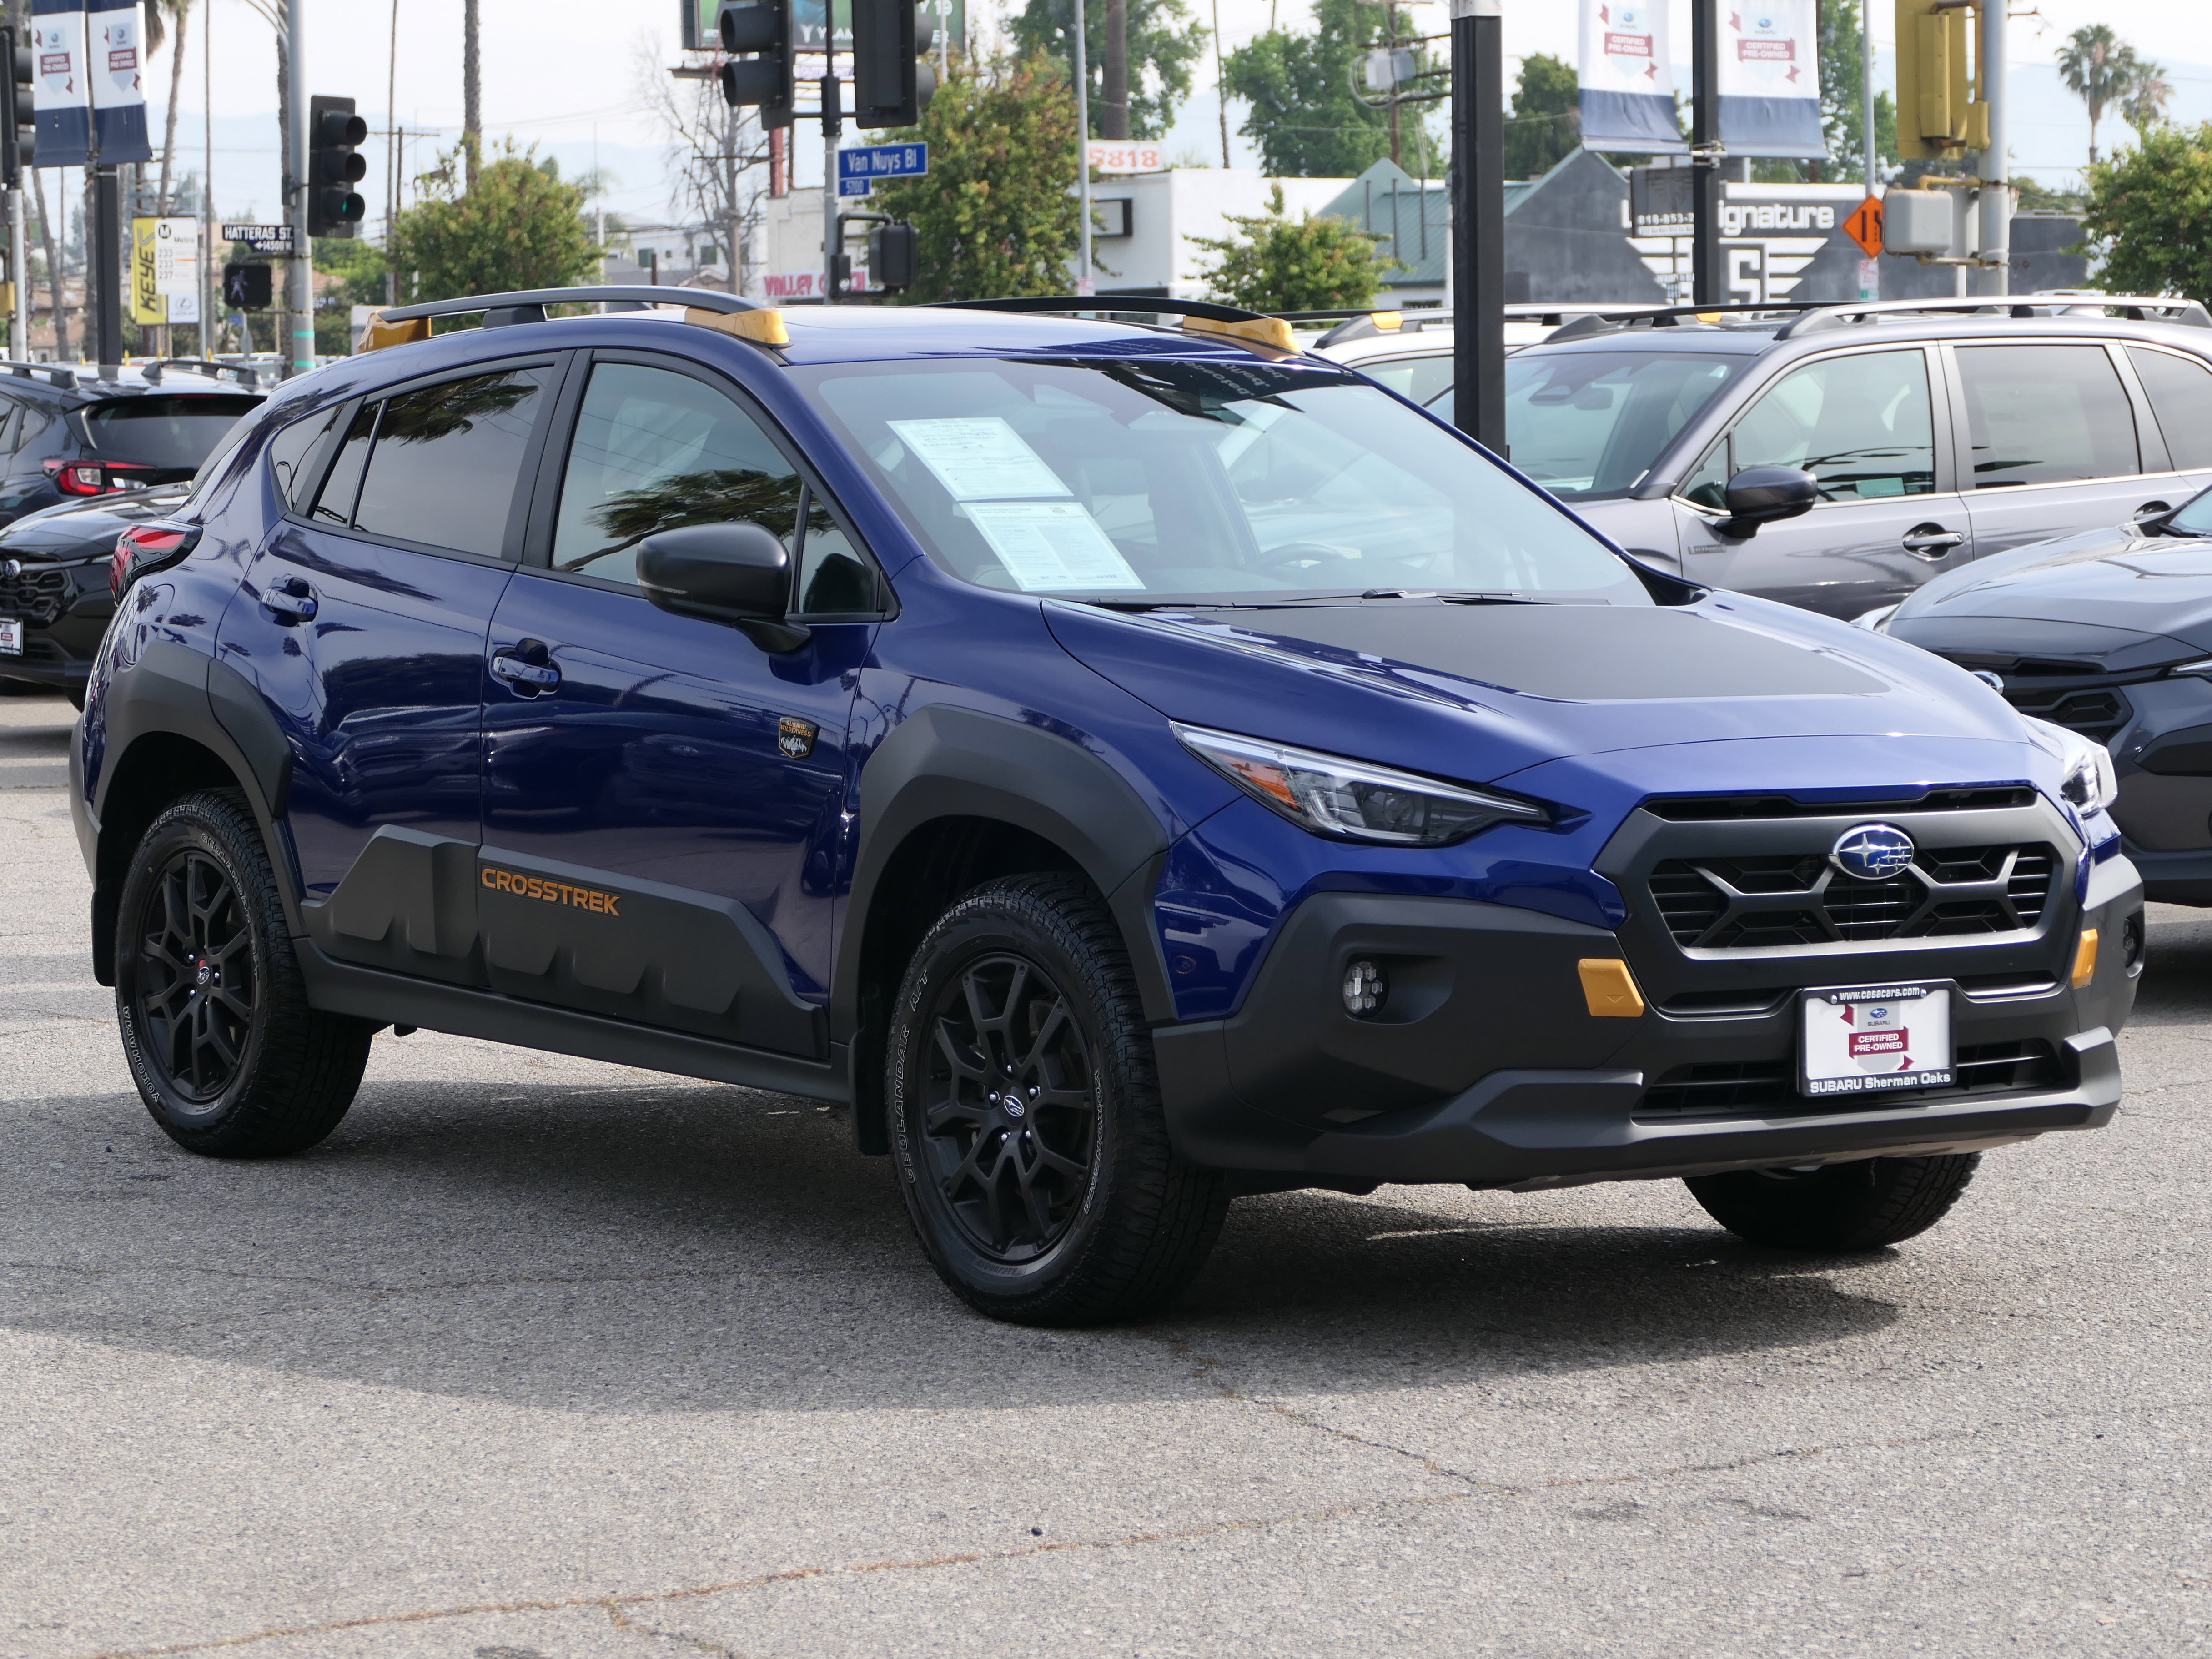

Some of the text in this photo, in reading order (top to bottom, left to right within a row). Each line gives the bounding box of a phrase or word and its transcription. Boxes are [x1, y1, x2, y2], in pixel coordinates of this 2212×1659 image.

[1611, 35, 1645, 46] CERTIFIED
[1745, 42, 1785, 50] CERTIFIED
[1608, 43, 1649, 55] PRE-OWNED
[1743, 49, 1790, 59] PRE-OWNED
[847, 148, 917, 175] Van Nuys Bl
[1089, 147, 1157, 168] 5818
[1718, 199, 1835, 237] ignature
[225, 226, 276, 241] HATTERAS
[764, 274, 813, 296] VALLEY
[780, 724, 811, 737] WILDERNESS
[786, 720, 807, 730] SUBARU
[481, 868, 621, 916] CROSSTREK
[1840, 987, 1920, 1001] www.casacars.com
[1858, 1033, 1899, 1043] CERTIFIED
[123, 1005, 160, 1103] YOKOHAMA
[1855, 1041, 1903, 1052] PRE-OWNED
[895, 967, 928, 1183] GEOLANDAR A/T
[1810, 1072, 1951, 1094] SUBARU Sherman Oaks
[1083, 1068, 1103, 1214] YOKOHAMA
